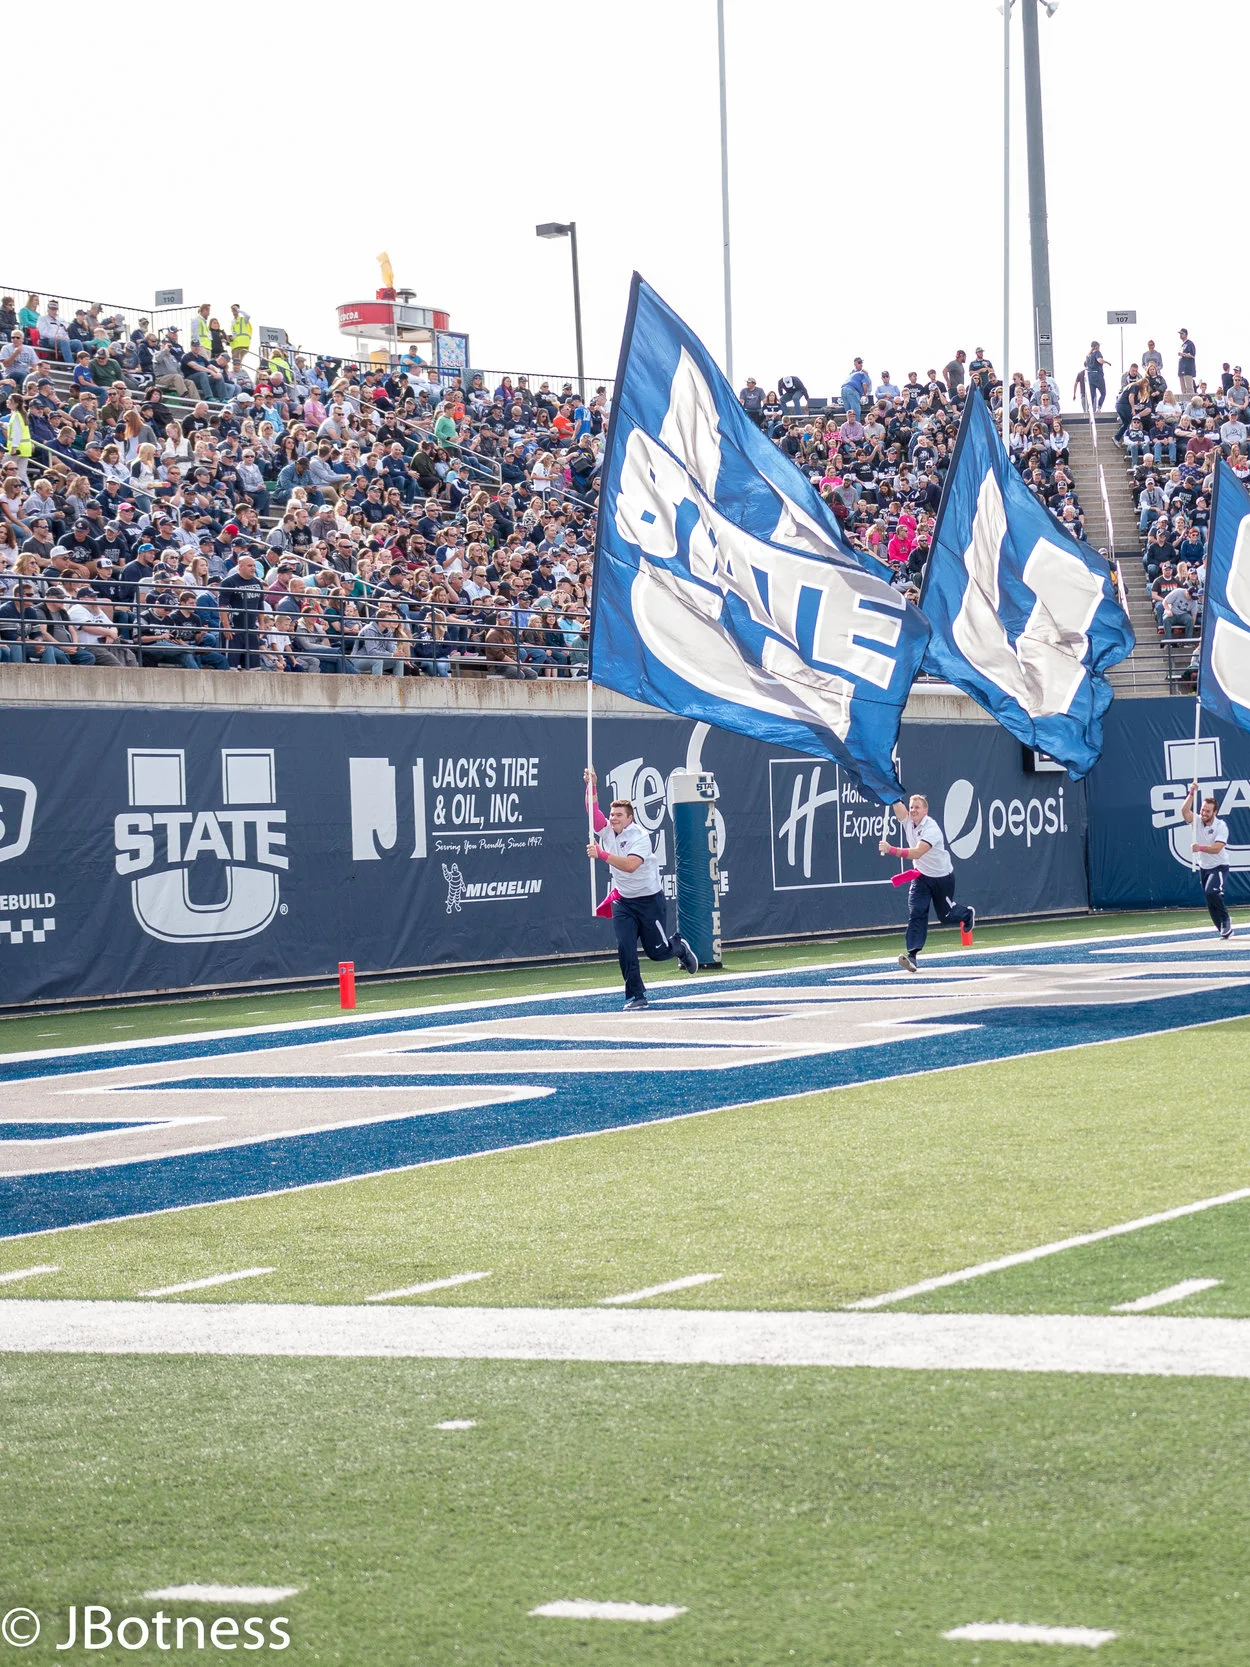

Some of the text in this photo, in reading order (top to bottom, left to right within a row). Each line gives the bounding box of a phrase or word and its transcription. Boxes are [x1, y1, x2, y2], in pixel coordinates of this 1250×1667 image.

[432, 757, 540, 788] JACK'S TIRE
[696, 783, 715, 791] STA
[433, 793, 523, 830] & OIL, INC.
[988, 786, 1064, 849] pepsi
[115, 810, 289, 875] STATE
[128, 748, 280, 943] U
[435, 839, 461, 855] Serving
[463, 839, 477, 855] You
[479, 838, 506, 854] Proudly
[508, 837, 526, 848] Since
[465, 879, 542, 897] MICHELIN
[704, 802, 722, 963] AGGIES
